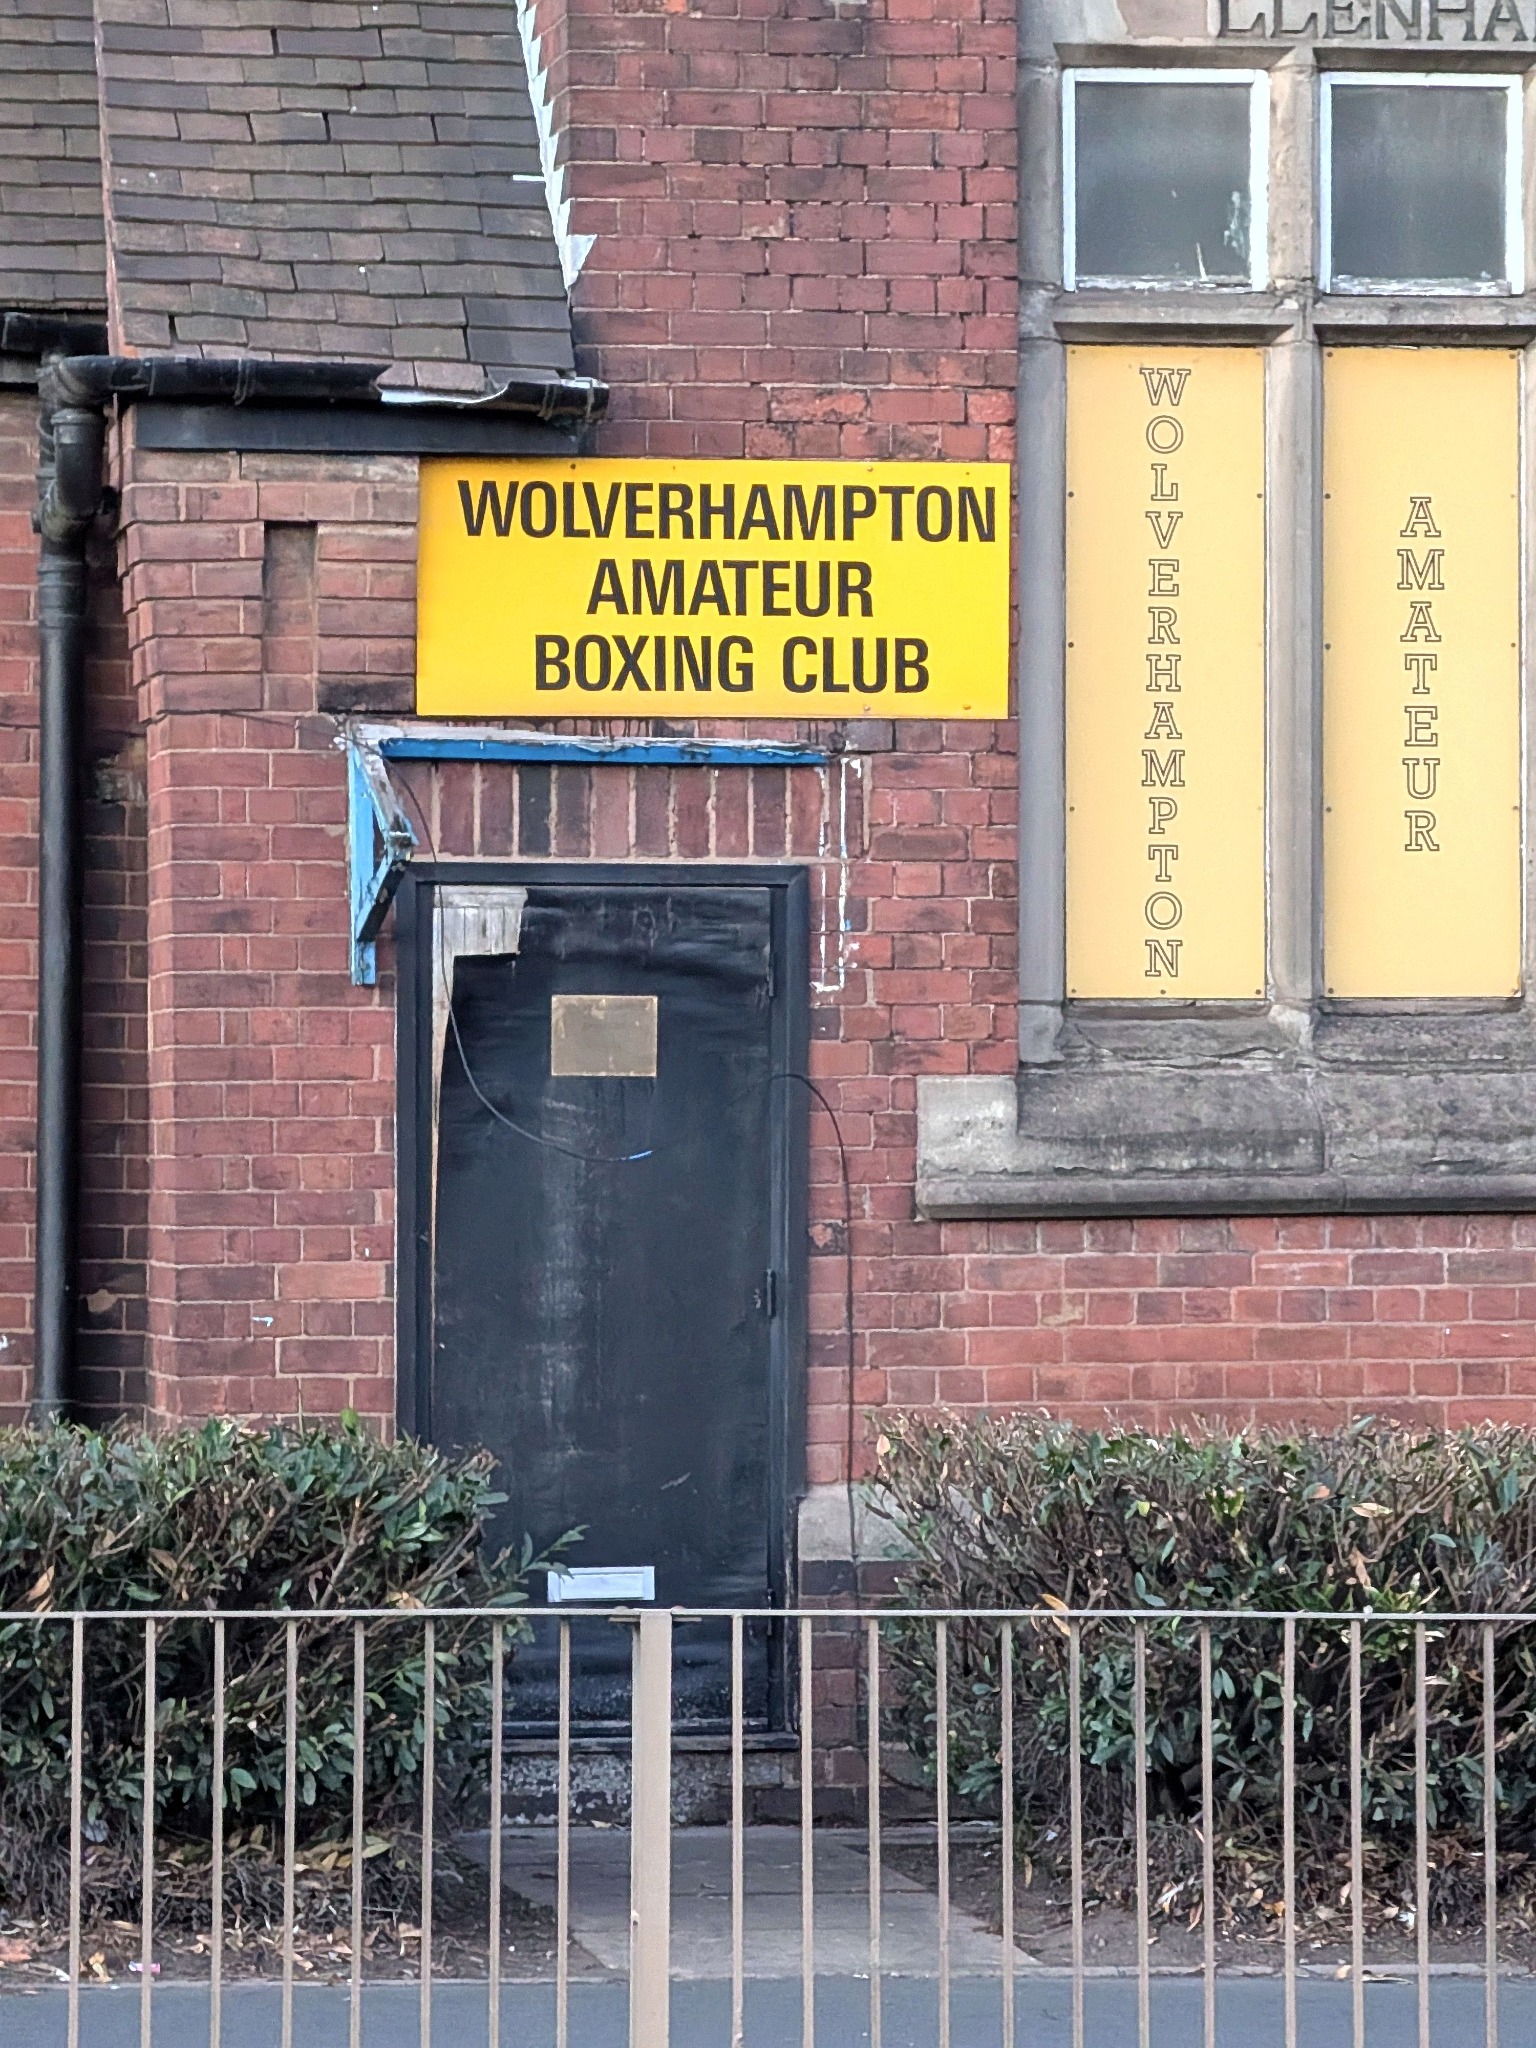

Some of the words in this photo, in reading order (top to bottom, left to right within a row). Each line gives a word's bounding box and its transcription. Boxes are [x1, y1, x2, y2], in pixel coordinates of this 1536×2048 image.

[1217, 0, 1536, 42] LLENHA
[457, 480, 996, 543] WOLVERHAMPTON
[586, 558, 874, 618] AMATEUR
[535, 634, 754, 693] BOXING
[782, 636, 929, 694] CLUB
[1139, 367, 1192, 977] WOLVERHAMPTON
[1397, 497, 1445, 851] AMATEUR
